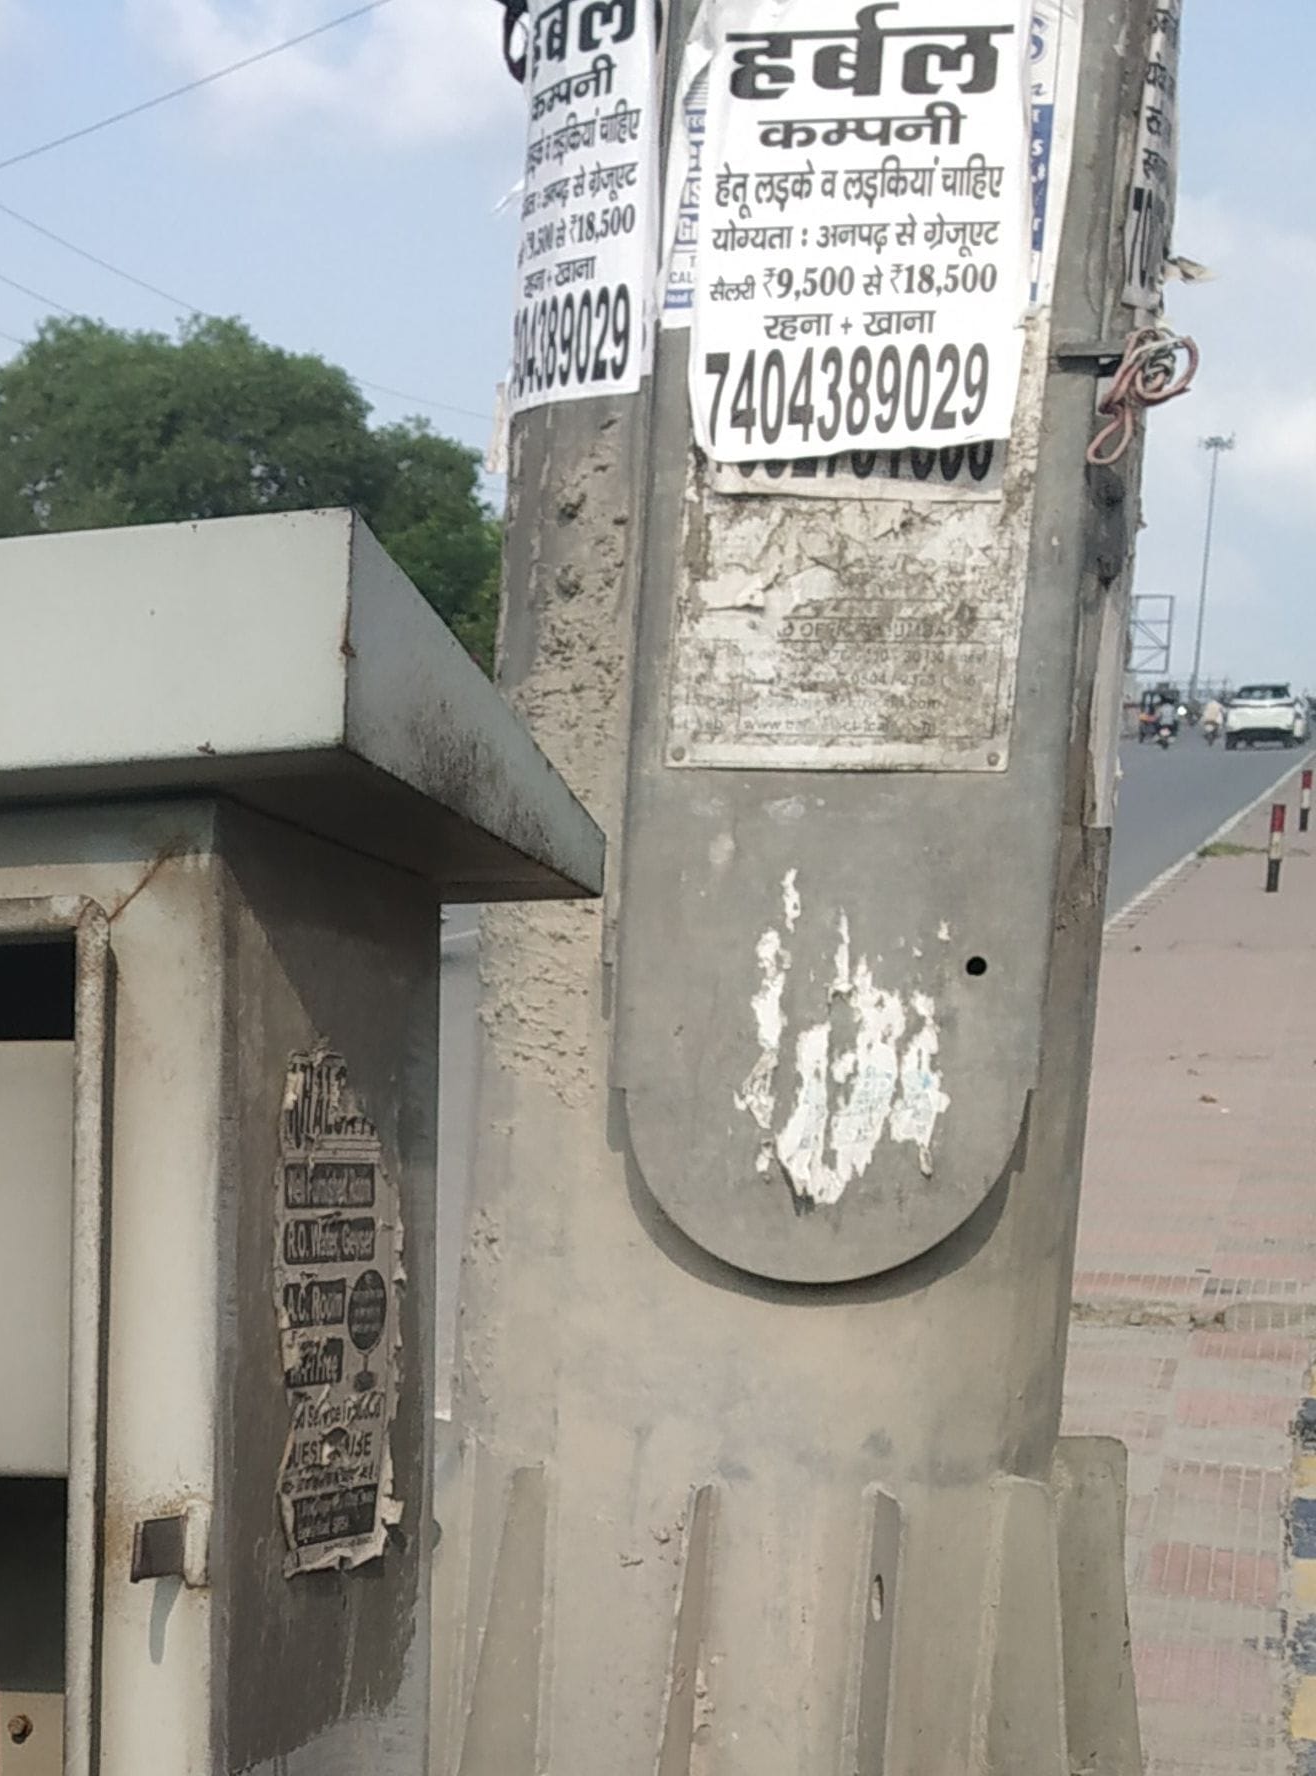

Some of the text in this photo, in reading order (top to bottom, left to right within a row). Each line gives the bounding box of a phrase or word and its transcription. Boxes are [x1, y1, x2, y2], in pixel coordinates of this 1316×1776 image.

[726, 1, 1014, 100] हर्बल
[757, 101, 967, 149] कम्पनी
[755, 158, 815, 212] लड़के
[821, 170, 838, 199] व
[844, 154, 940, 208] लड़कियां
[942, 153, 1004, 199] चाहिए
[712, 219, 793, 251] योग्यता
[816, 223, 890, 254] अनपढ़
[895, 214, 916, 246] से
[923, 215, 1000, 257] ग्रेजूएट
[709, 275, 756, 301] सैलरी
[762, 266, 855, 301] ₹9,500
[862, 265, 883, 295] से
[890, 263, 997, 296] ₹18,500
[763, 313, 833, 341] रहना
[863, 310, 936, 336] खाना
[705, 343, 989, 446] 7404389029
